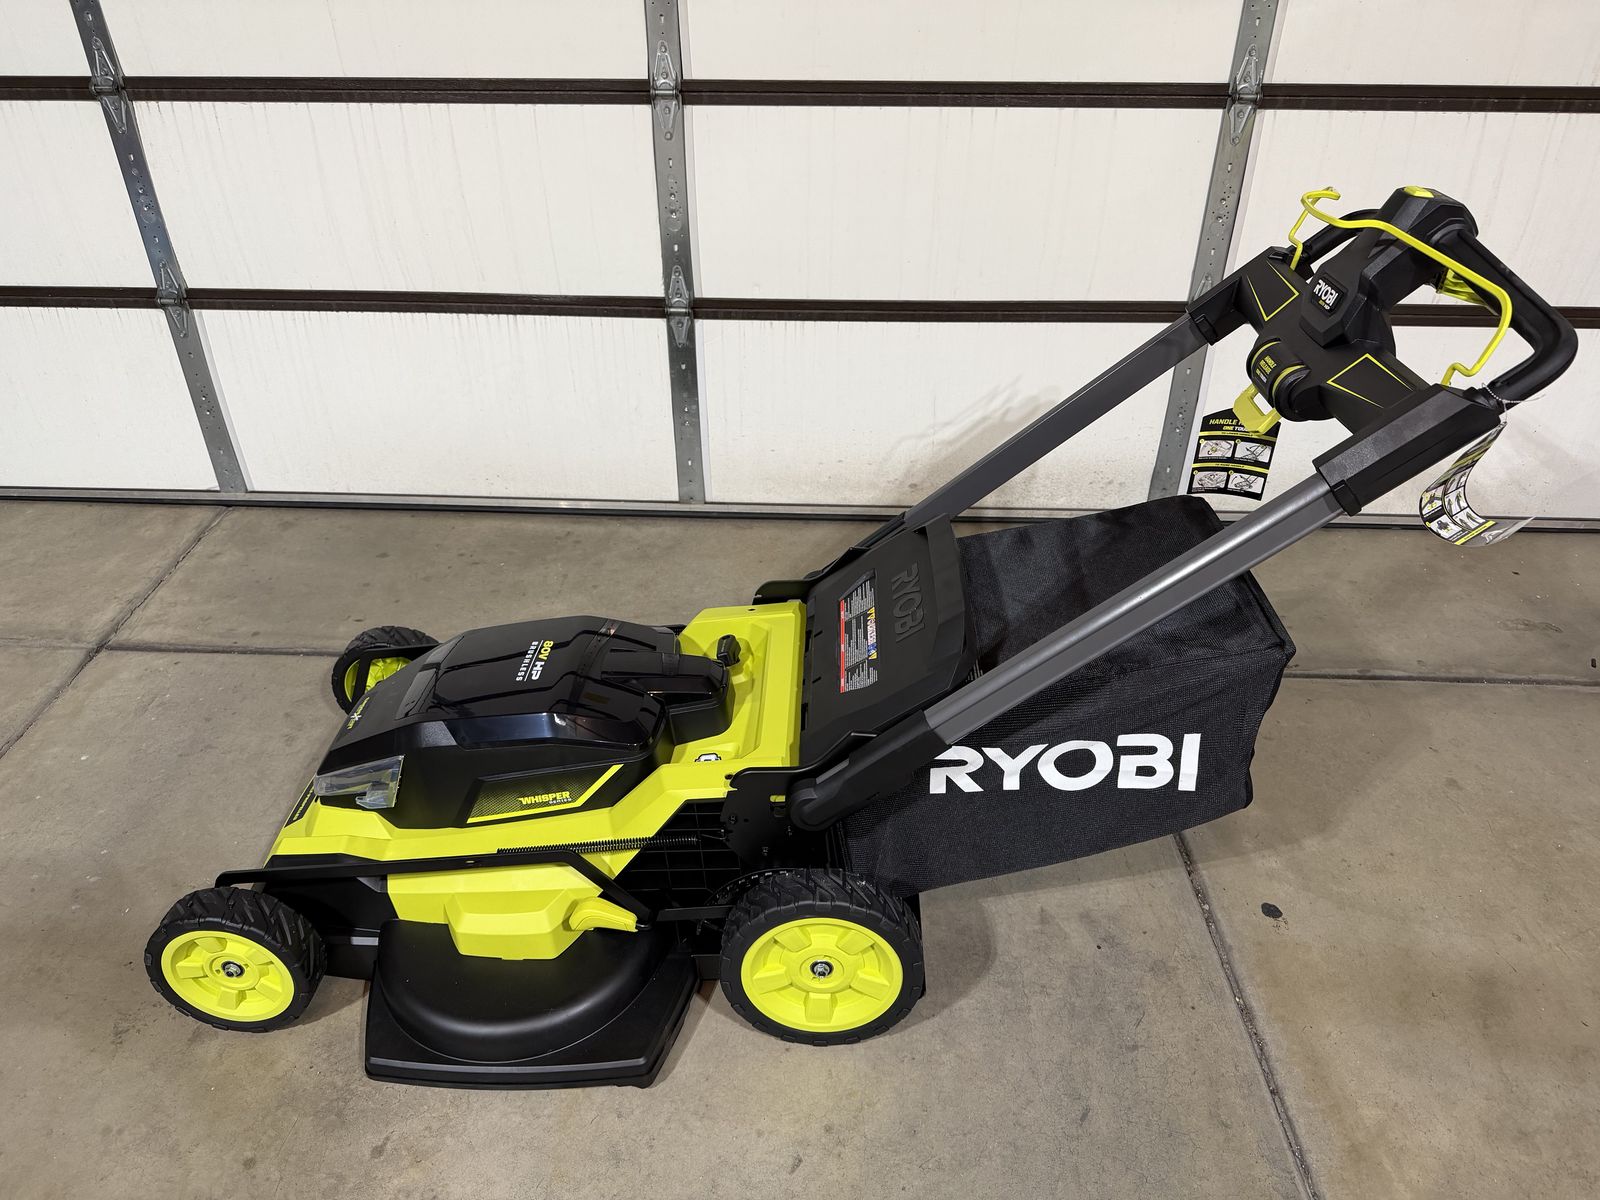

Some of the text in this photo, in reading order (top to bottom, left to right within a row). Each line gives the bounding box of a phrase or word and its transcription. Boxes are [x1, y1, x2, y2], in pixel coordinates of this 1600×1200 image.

[1313, 279, 1339, 307] RYOBI
[891, 561, 925, 644] RYOBI
[515, 641, 539, 681] BRUSHLESS
[531, 640, 554, 680] 80V HP
[929, 732, 1202, 794] RYOBI
[519, 791, 571, 805] WHISPER
